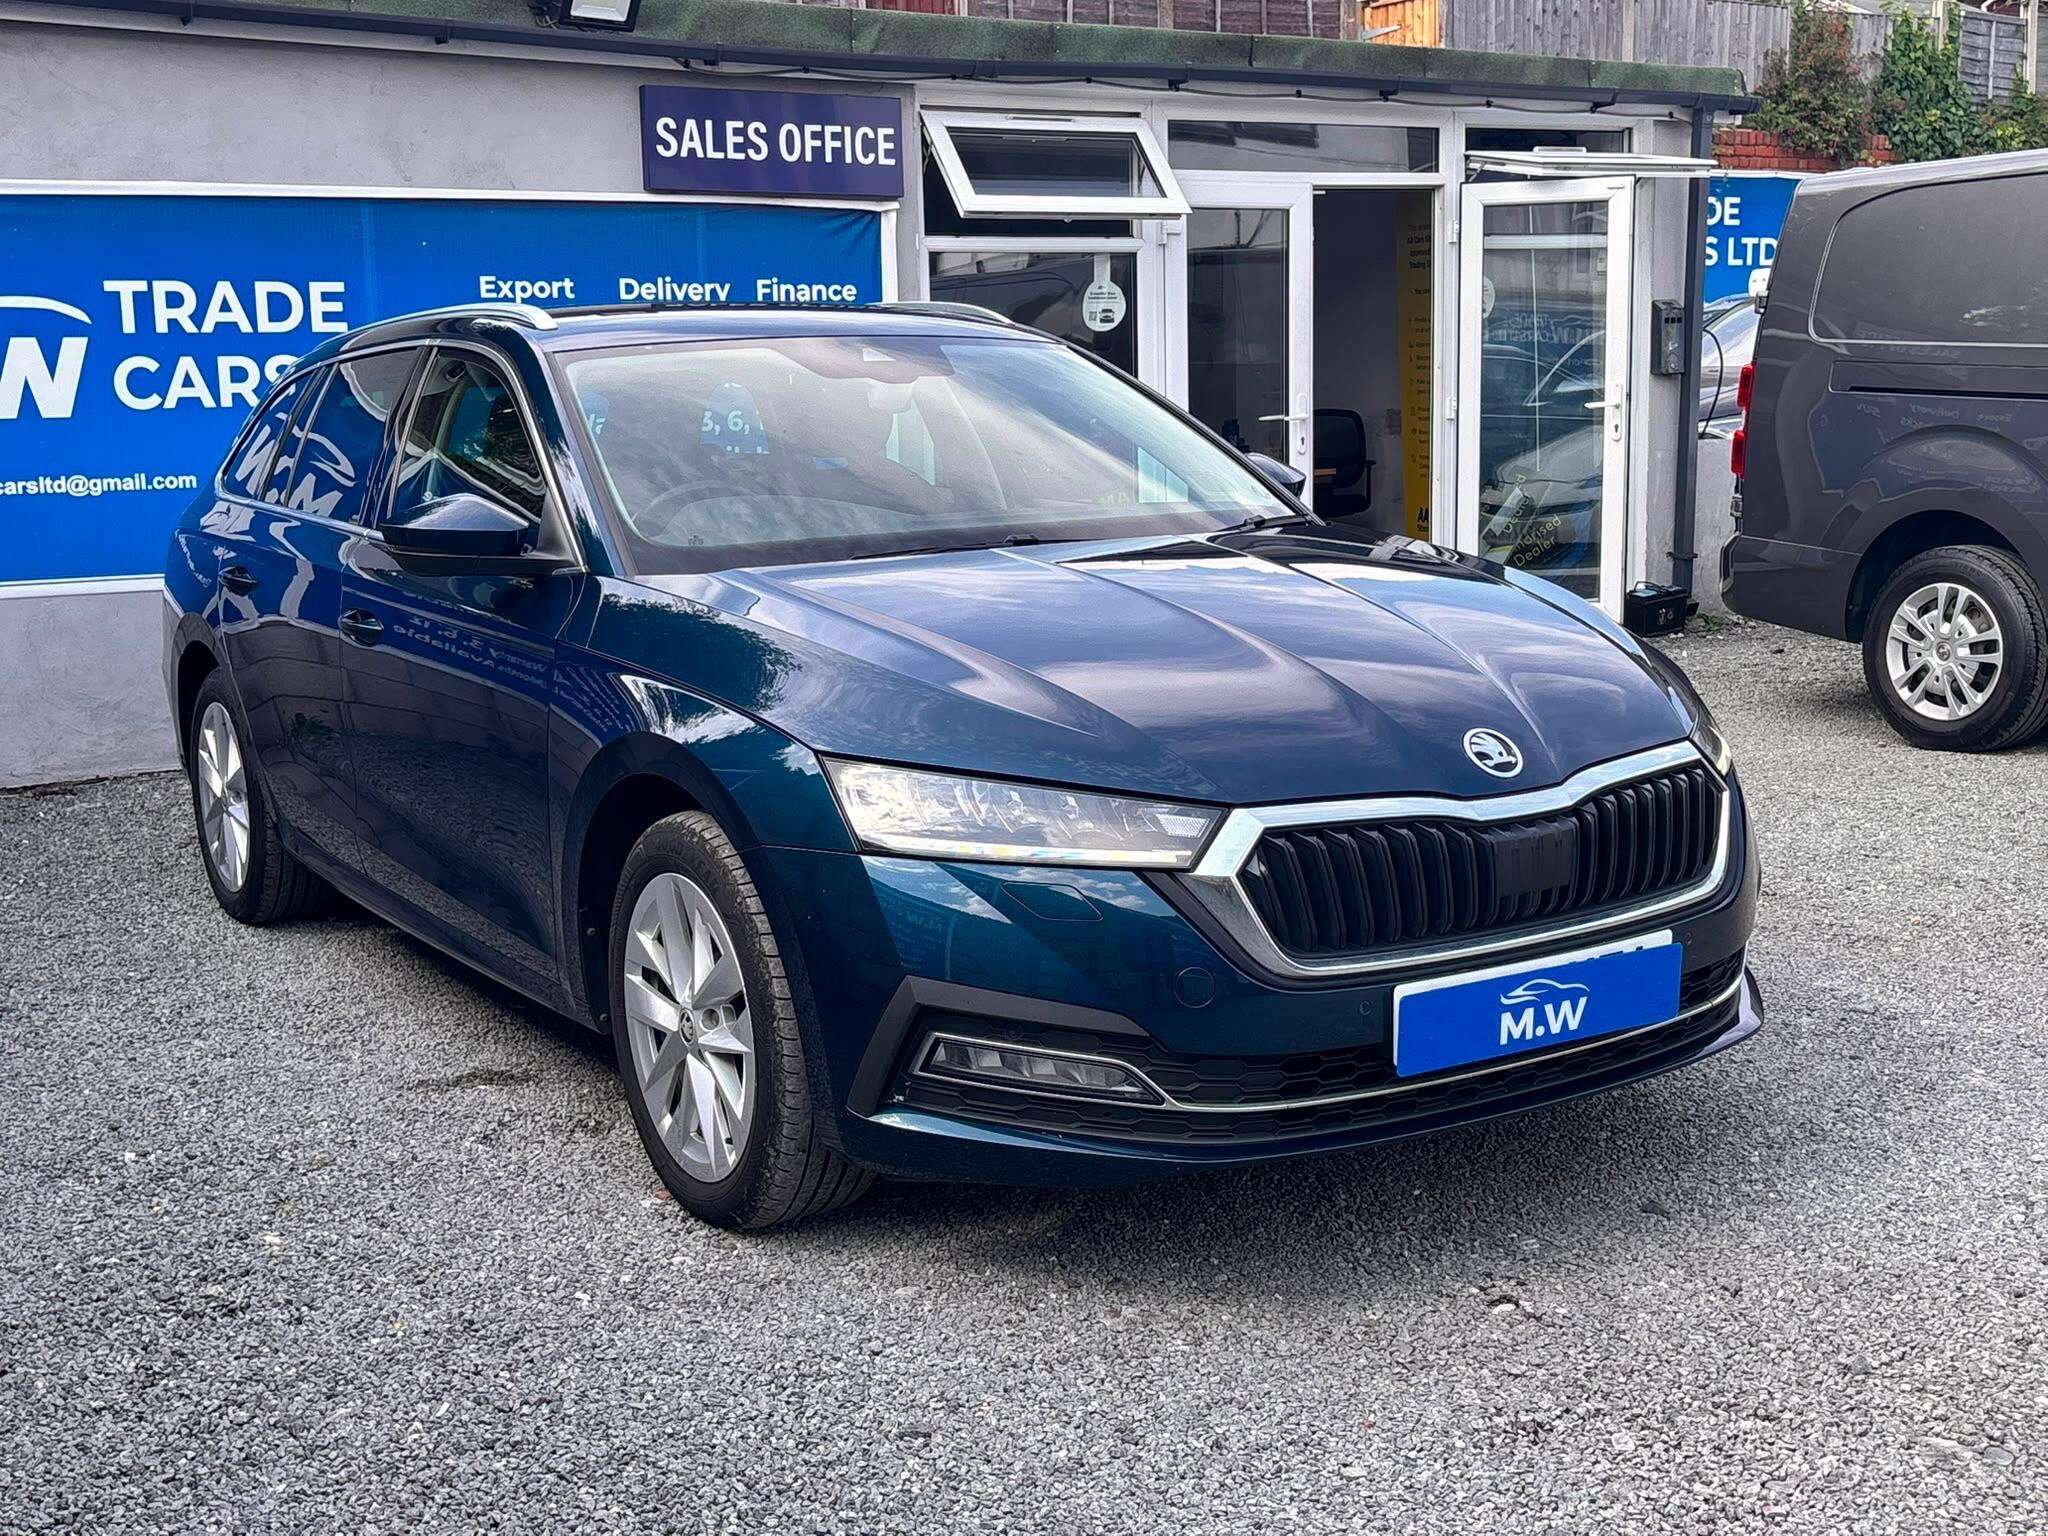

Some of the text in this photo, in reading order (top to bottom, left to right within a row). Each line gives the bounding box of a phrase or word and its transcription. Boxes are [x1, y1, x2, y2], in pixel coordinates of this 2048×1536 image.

[656, 117, 896, 166] SALES OFFICE
[1727, 237, 1778, 267] LTD
[103, 280, 349, 333] TRADE
[479, 276, 858, 303] Export Delivery Finance
[1513, 536, 1556, 567] Dealer
[1499, 997, 1588, 1045] M.W
